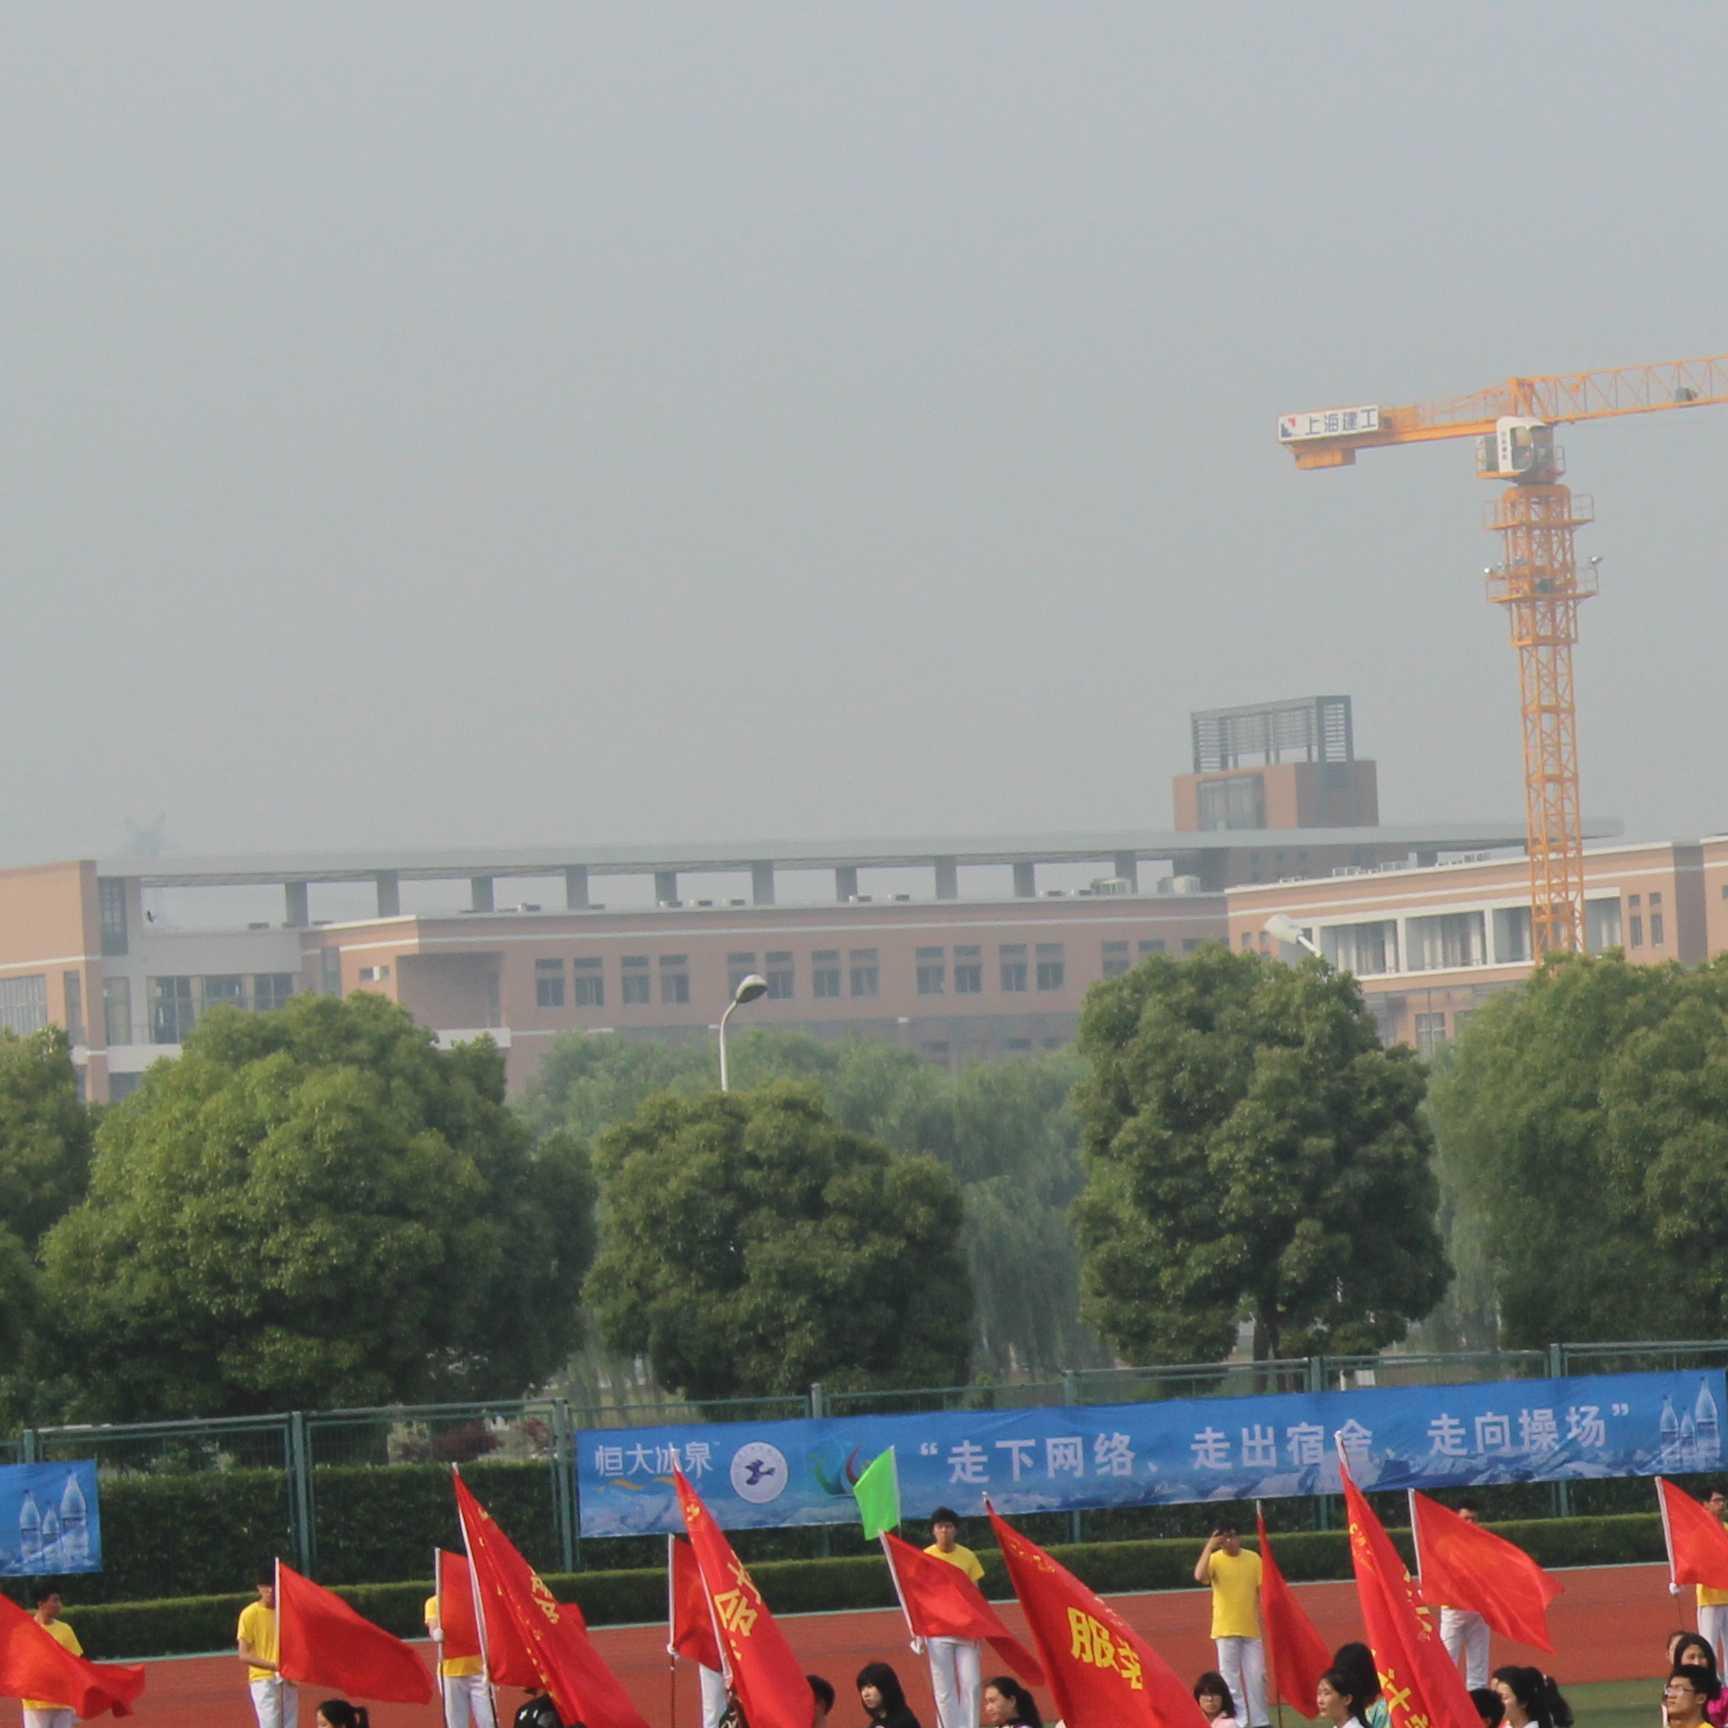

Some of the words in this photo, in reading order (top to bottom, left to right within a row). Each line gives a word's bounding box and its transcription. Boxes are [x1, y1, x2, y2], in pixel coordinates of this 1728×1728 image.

[1304, 407, 1377, 436] 上海建工
[594, 1440, 714, 1477] 恒大冰泉
